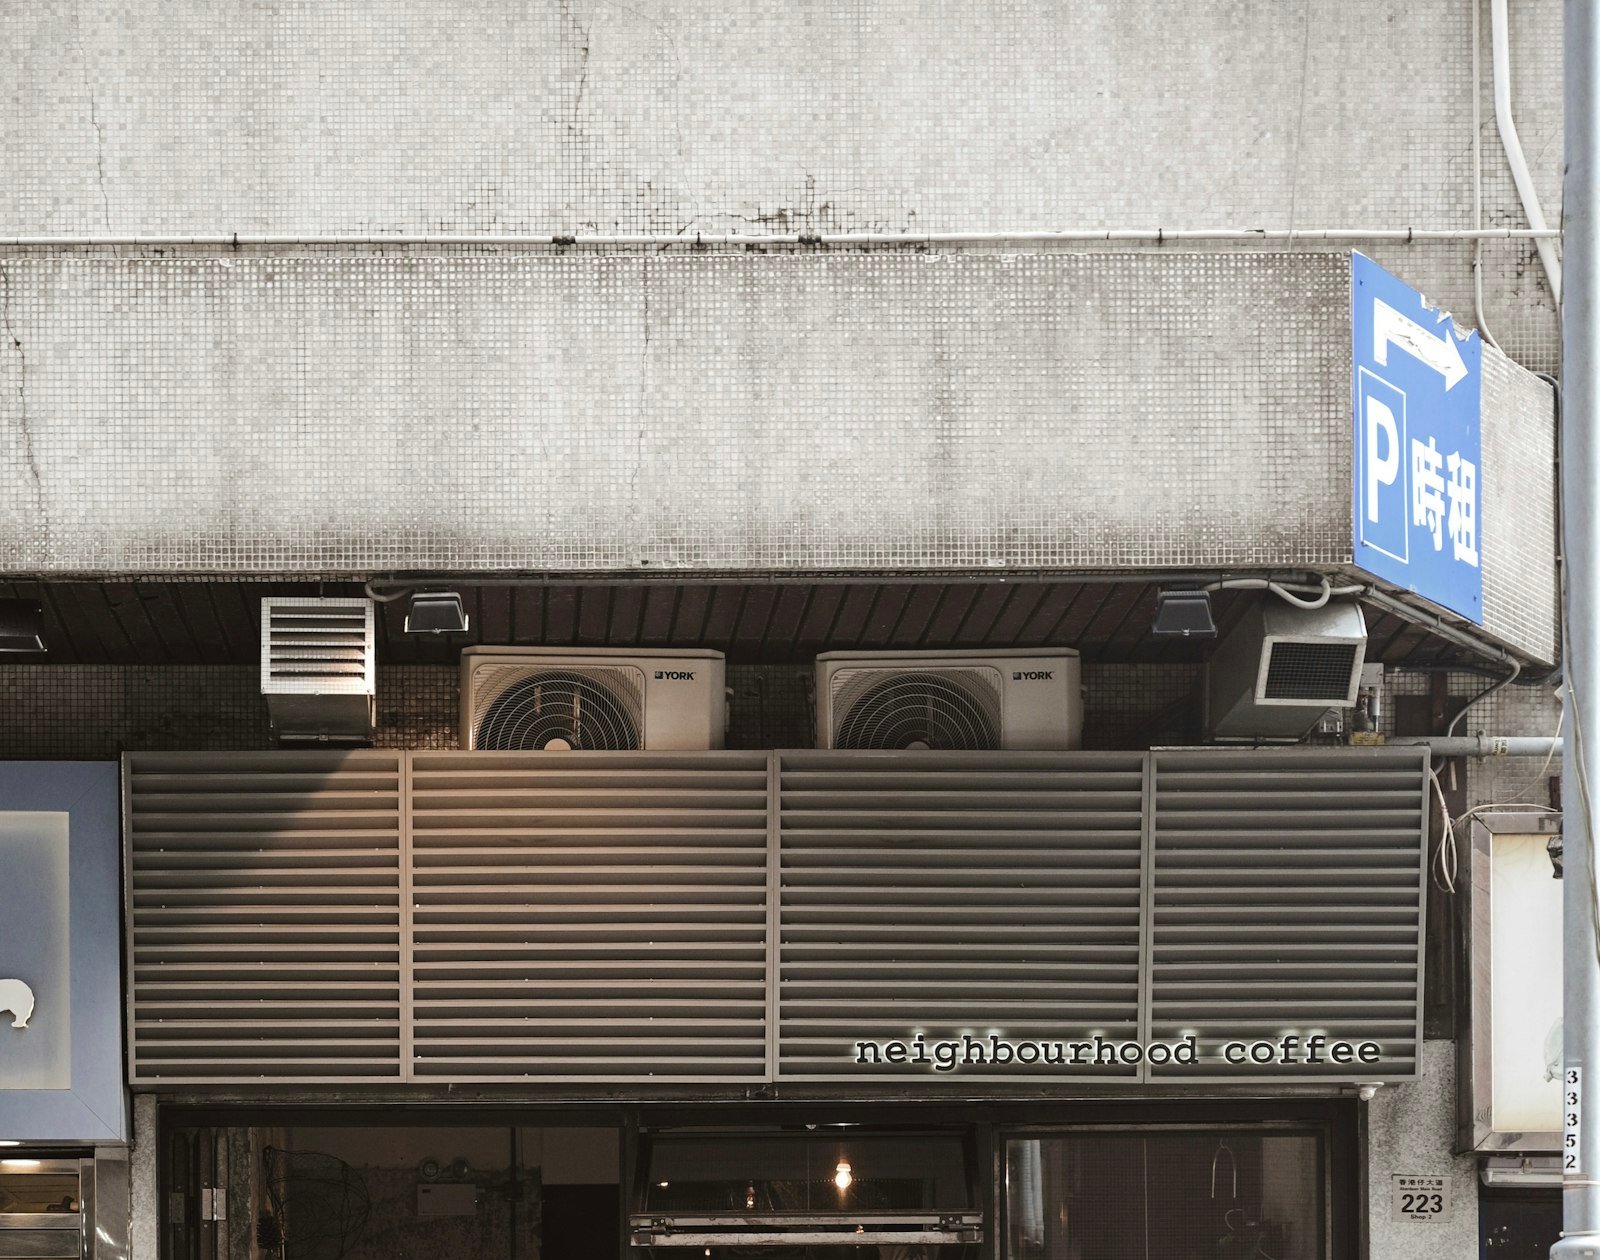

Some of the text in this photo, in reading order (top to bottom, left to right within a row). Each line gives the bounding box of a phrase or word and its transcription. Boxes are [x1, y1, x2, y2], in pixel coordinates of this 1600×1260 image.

[1367, 395, 1400, 523] P
[1411, 435, 1479, 568] 時租
[664, 671, 694, 680] YORK
[1022, 671, 1053, 680] YORK
[856, 1032, 1382, 1071] neighbourhood coffee
[1401, 1194, 1443, 1213] 223
